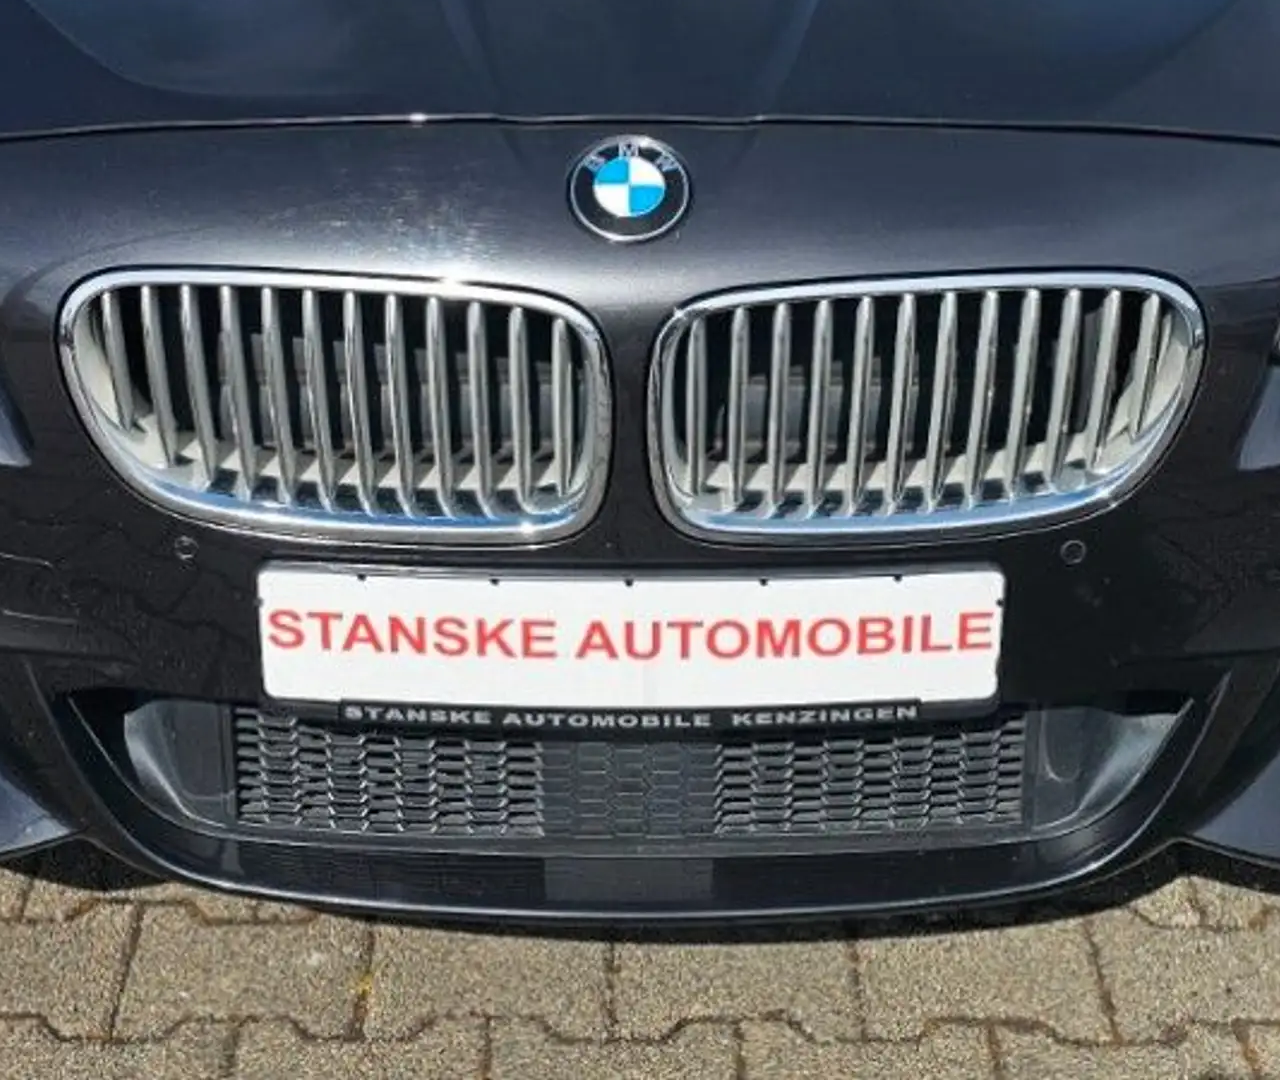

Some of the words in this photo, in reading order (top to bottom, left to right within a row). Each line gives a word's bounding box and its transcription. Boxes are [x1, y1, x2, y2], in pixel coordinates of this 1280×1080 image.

[267, 608, 556, 659] STANSKE
[576, 611, 994, 660] AUTOMOBILE
[344, 704, 492, 725] STANSKE
[503, 711, 711, 728] AUTOMOBILE
[731, 705, 918, 726] KENZINGEN
